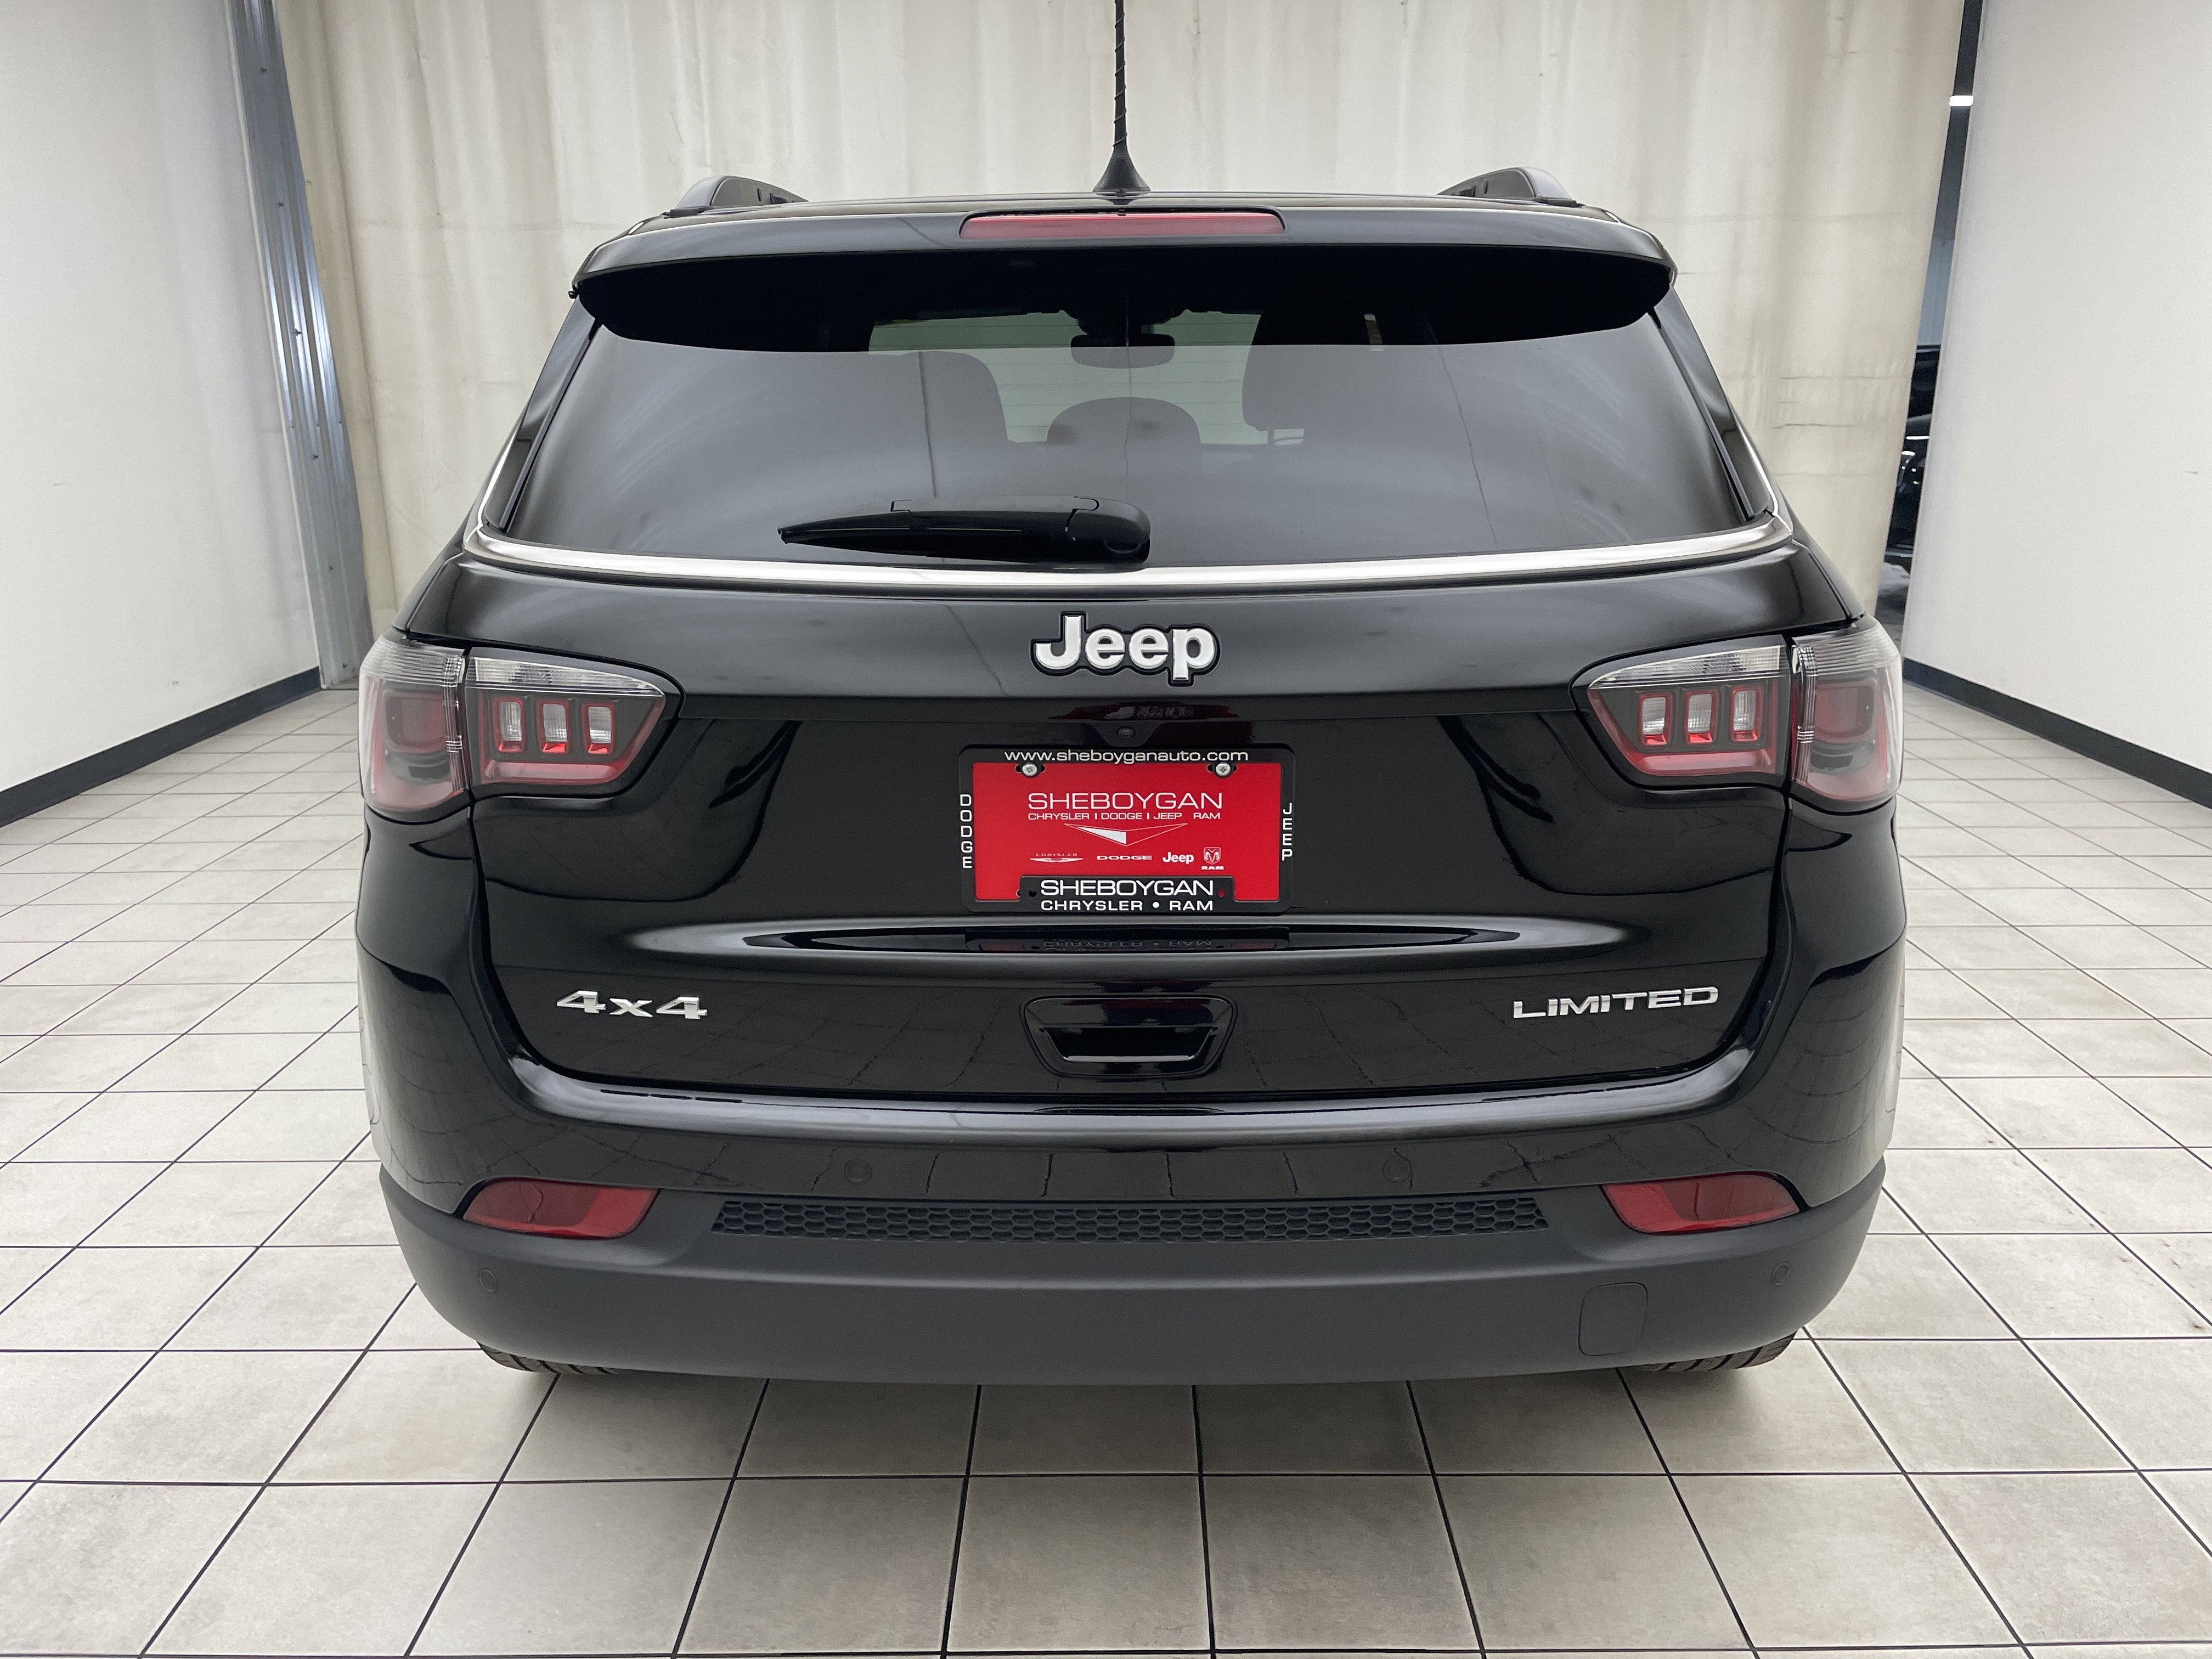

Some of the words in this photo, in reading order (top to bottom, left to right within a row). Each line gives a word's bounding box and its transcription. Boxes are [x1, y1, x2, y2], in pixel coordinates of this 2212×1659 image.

[1034, 614, 1215, 681] Jeep
[1004, 749, 1249, 765] www.sheboyganauto.com
[1028, 792, 1223, 810] SHEBOYGAN
[960, 794, 973, 868] DODGE
[1282, 802, 1293, 861] JEEP
[1162, 851, 1195, 865] Jeep
[1041, 879, 1214, 896] SHEBOYGAN
[1041, 900, 1143, 911] CHRYSLER
[1169, 900, 1214, 911] RAM
[556, 990, 708, 1020] 4x4
[1513, 985, 1719, 1019] LIMITED
